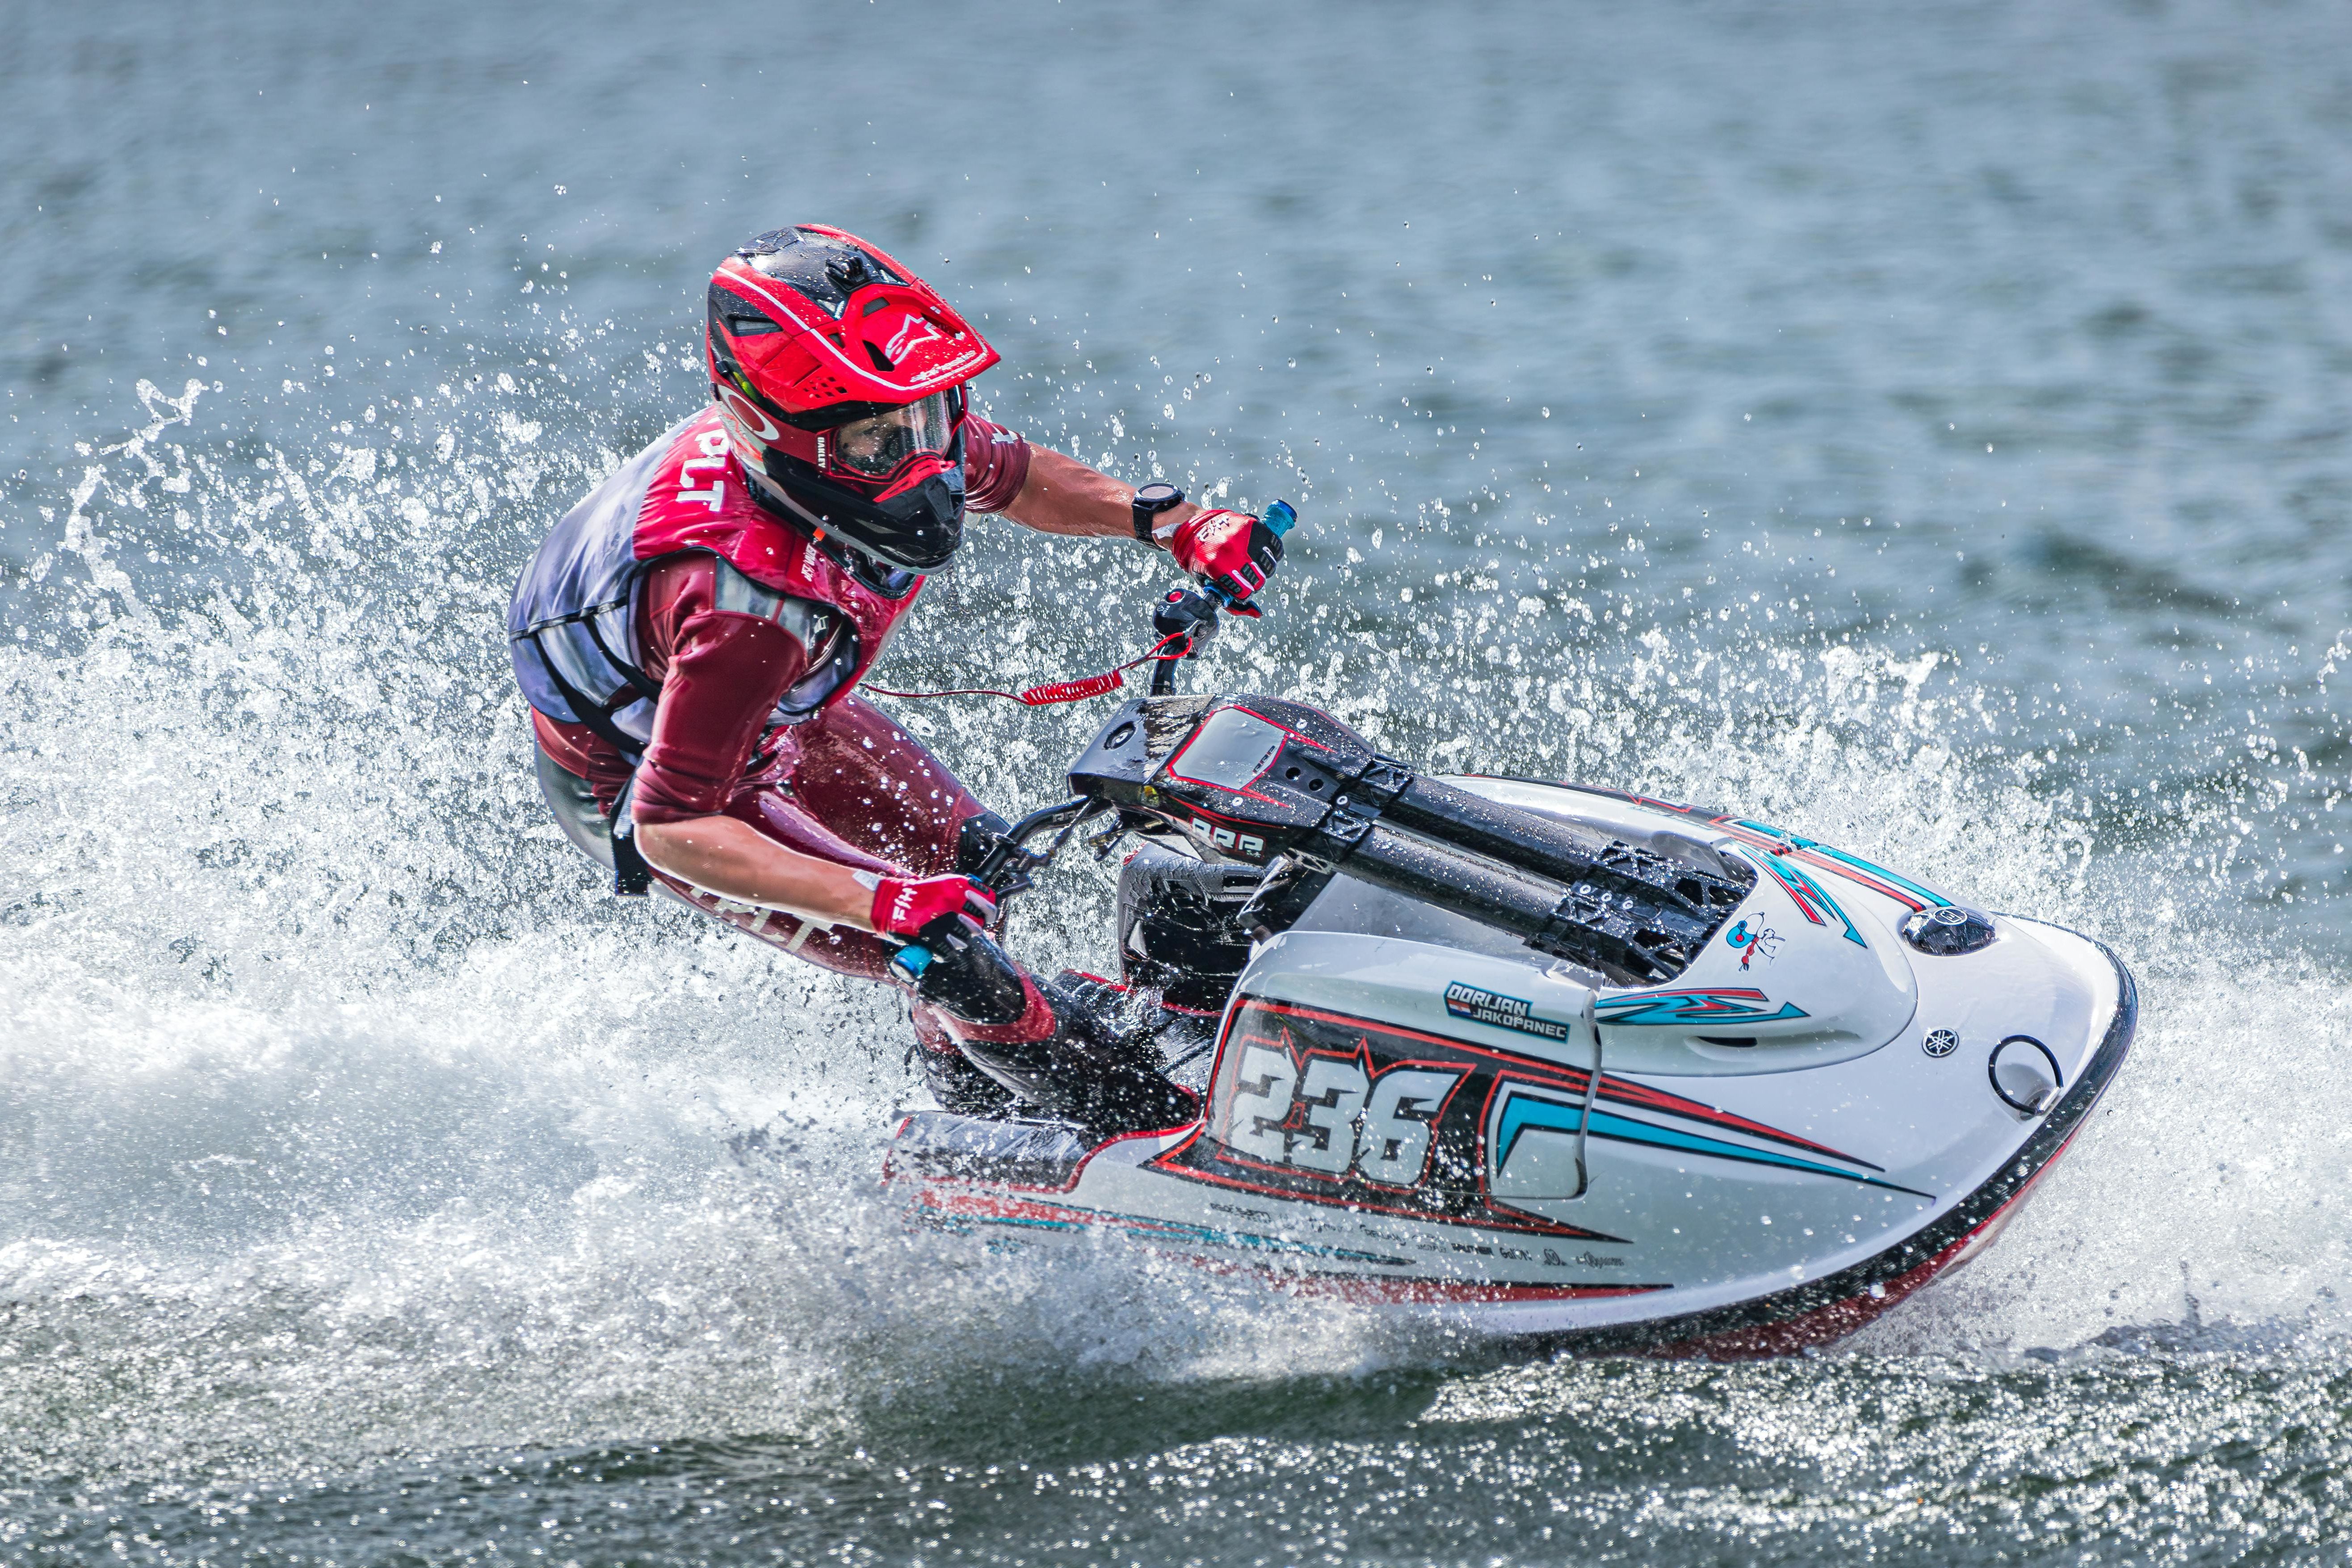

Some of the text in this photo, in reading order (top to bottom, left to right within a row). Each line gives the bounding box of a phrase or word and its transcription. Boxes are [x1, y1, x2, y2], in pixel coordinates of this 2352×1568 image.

[817, 437, 826, 468] OAKLEY
[1448, 984, 1529, 1017] DORIJAN
[1473, 1007, 1567, 1039] JAKOPANEC
[1231, 1045, 1459, 1186] 236
